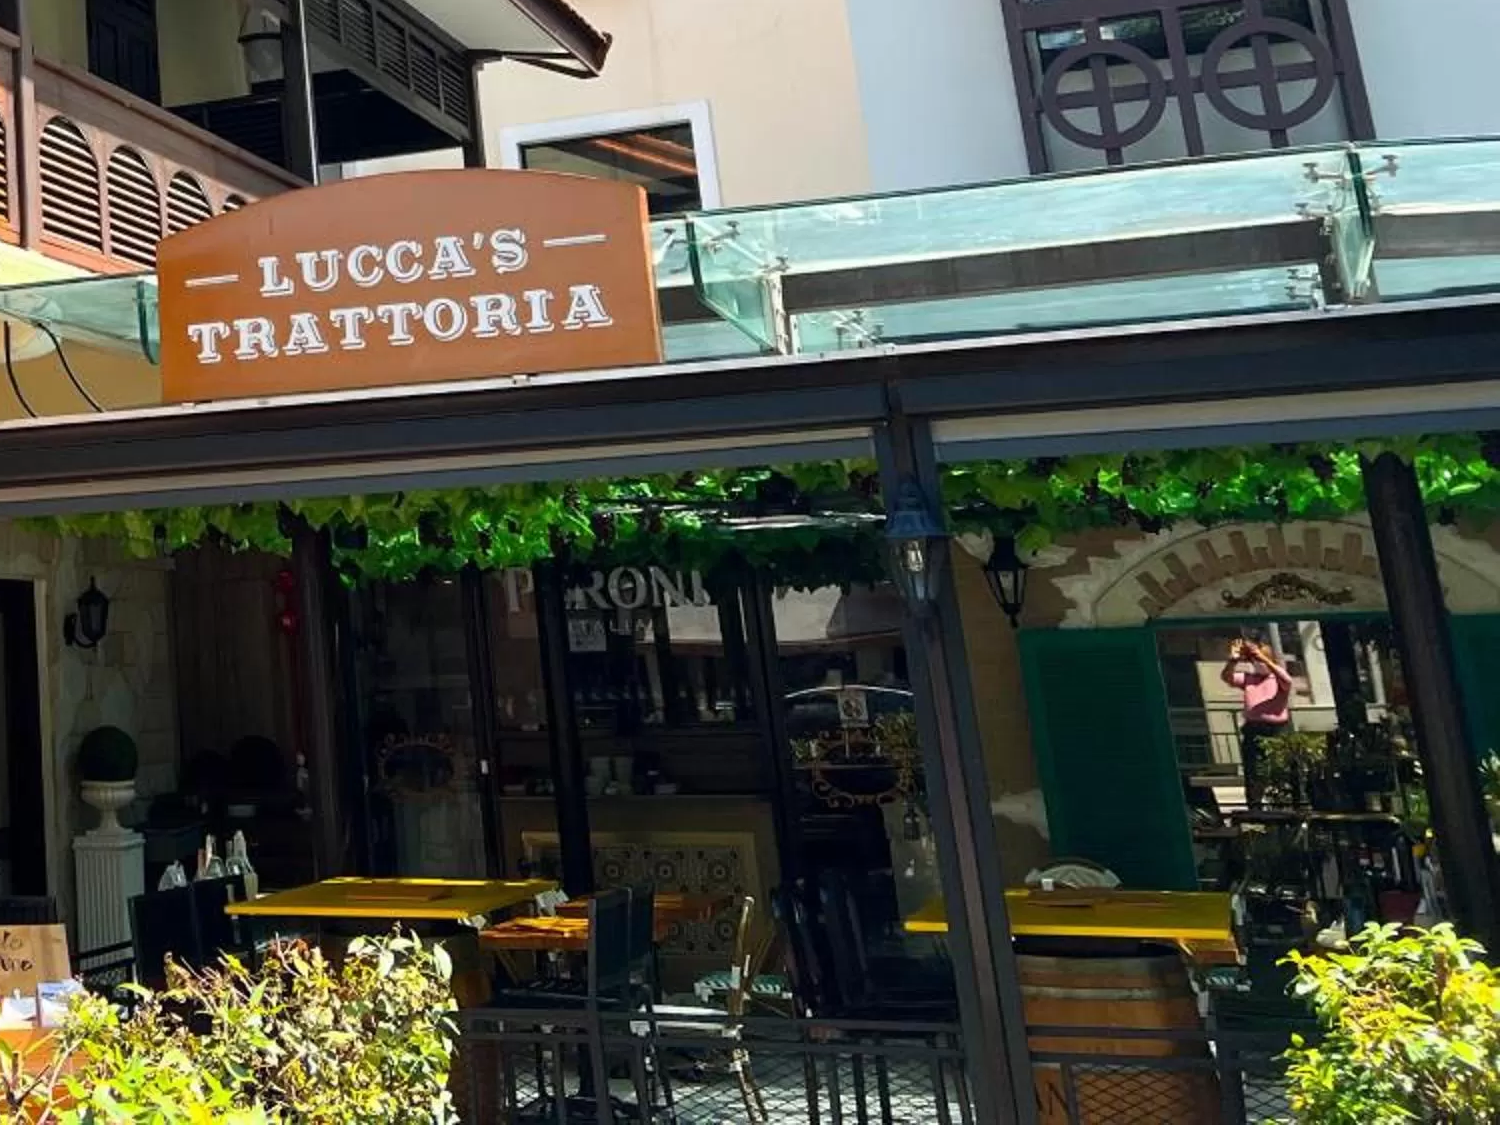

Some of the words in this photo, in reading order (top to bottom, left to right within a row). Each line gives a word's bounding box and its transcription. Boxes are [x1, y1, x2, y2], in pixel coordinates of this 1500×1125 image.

[258, 229, 529, 297] LUCCA'S
[187, 284, 613, 365] TRATTORIA
[503, 565, 708, 613] PRONI
